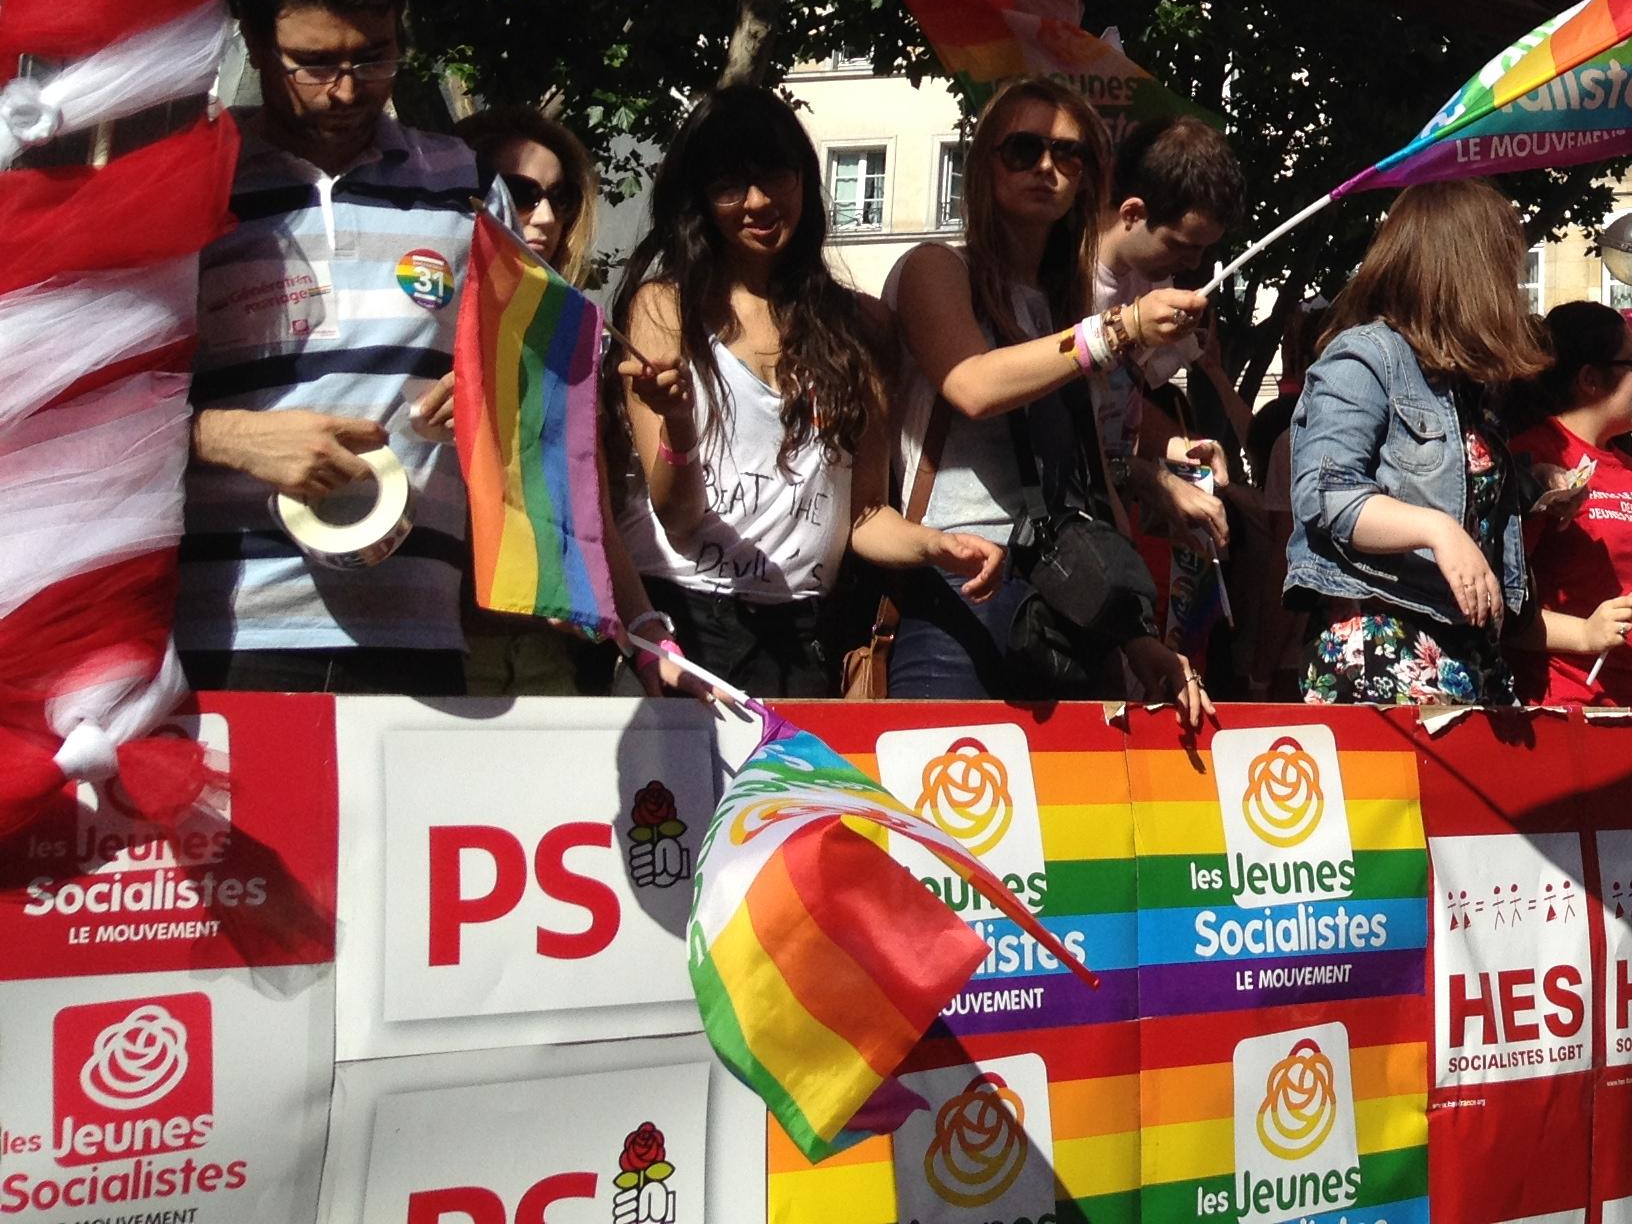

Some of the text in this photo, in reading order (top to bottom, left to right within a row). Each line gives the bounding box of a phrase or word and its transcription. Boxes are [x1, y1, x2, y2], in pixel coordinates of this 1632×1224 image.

[1456, 138, 1481, 163] LE
[411, 266, 444, 297] 31
[24, 871, 268, 917] Socialistes
[428, 822, 621, 966] PS
[1190, 852, 1356, 900] les Jeunes
[68, 920, 221, 945] LE MOUVEMENT
[1194, 903, 1388, 957] Socialistes
[1236, 963, 1352, 991] LE MOUVEMENT
[938, 988, 1045, 1017] OUVEMENT
[1449, 964, 1585, 1049] HES
[1448, 1043, 1584, 1073] SOCIALISTES LGBT
[2, 1114, 215, 1158] les Jeunes
[0, 1158, 248, 1214] Socialistes
[1197, 1186, 1229, 1217] les
[1235, 1165, 1361, 1216] Jeunes
